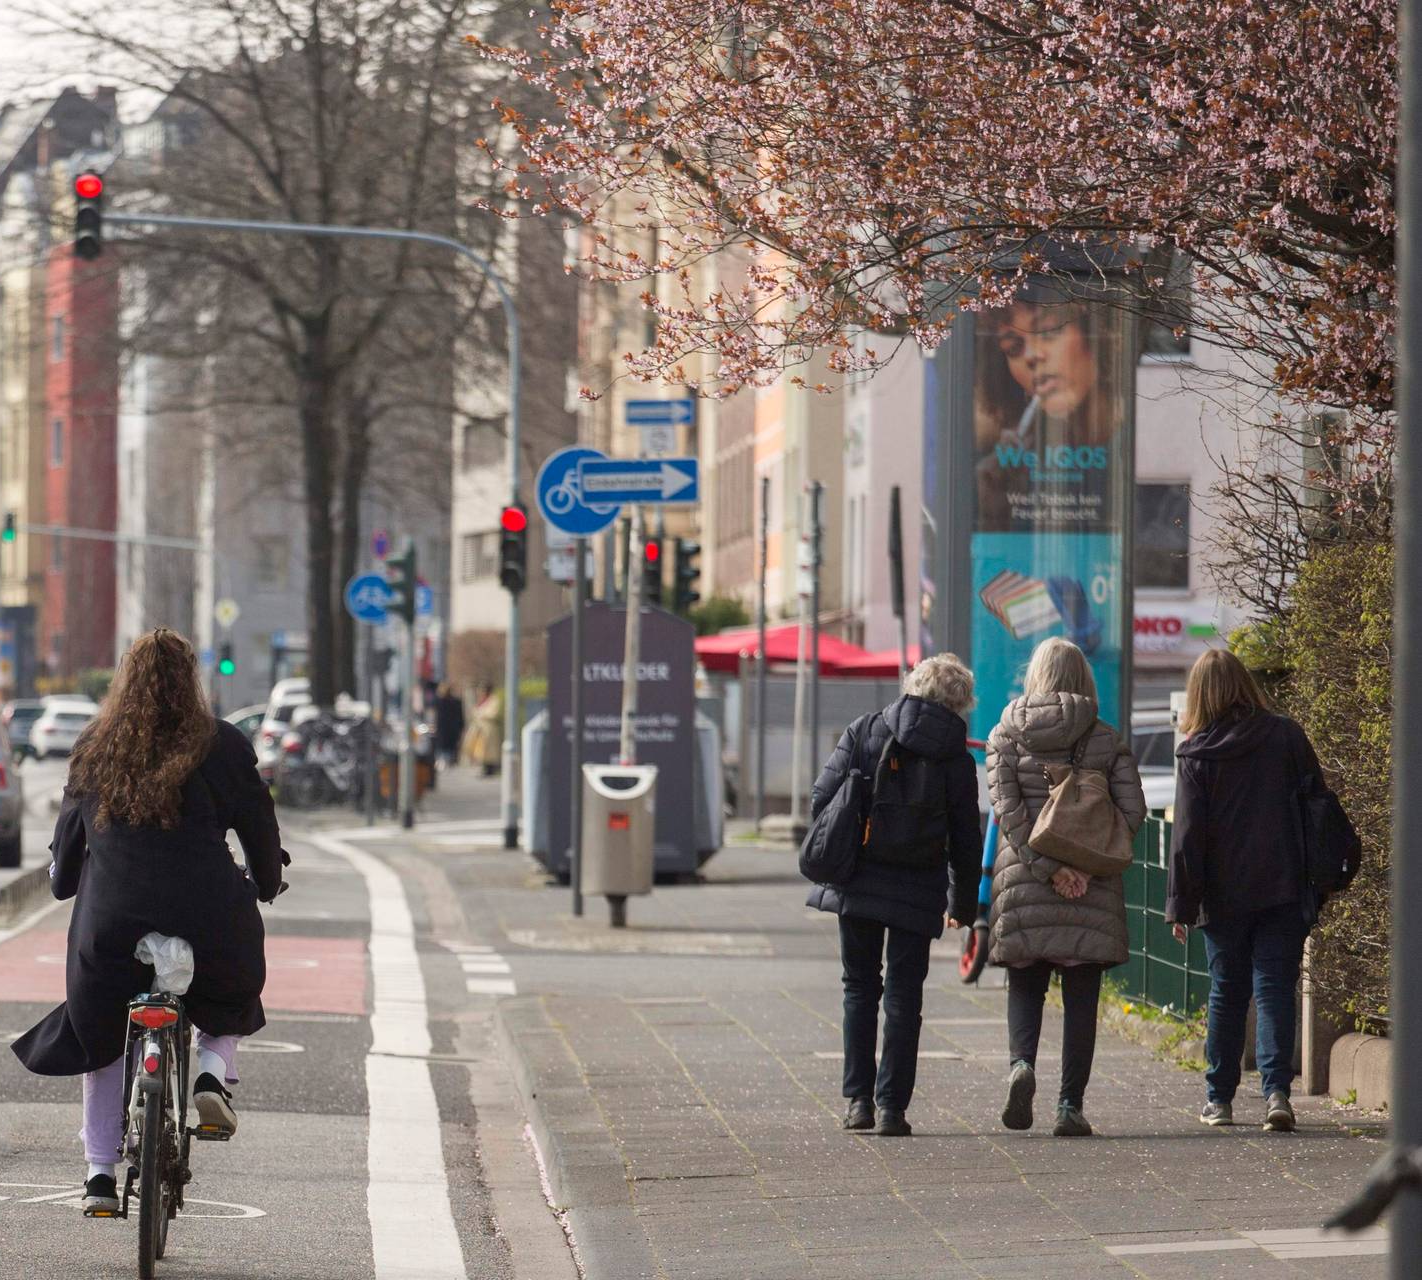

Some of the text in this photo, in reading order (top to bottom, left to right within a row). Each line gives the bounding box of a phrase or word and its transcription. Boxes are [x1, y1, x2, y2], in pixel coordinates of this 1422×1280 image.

[994, 443, 1107, 469] We IQOS
[581, 661, 670, 682] LTKLDER
